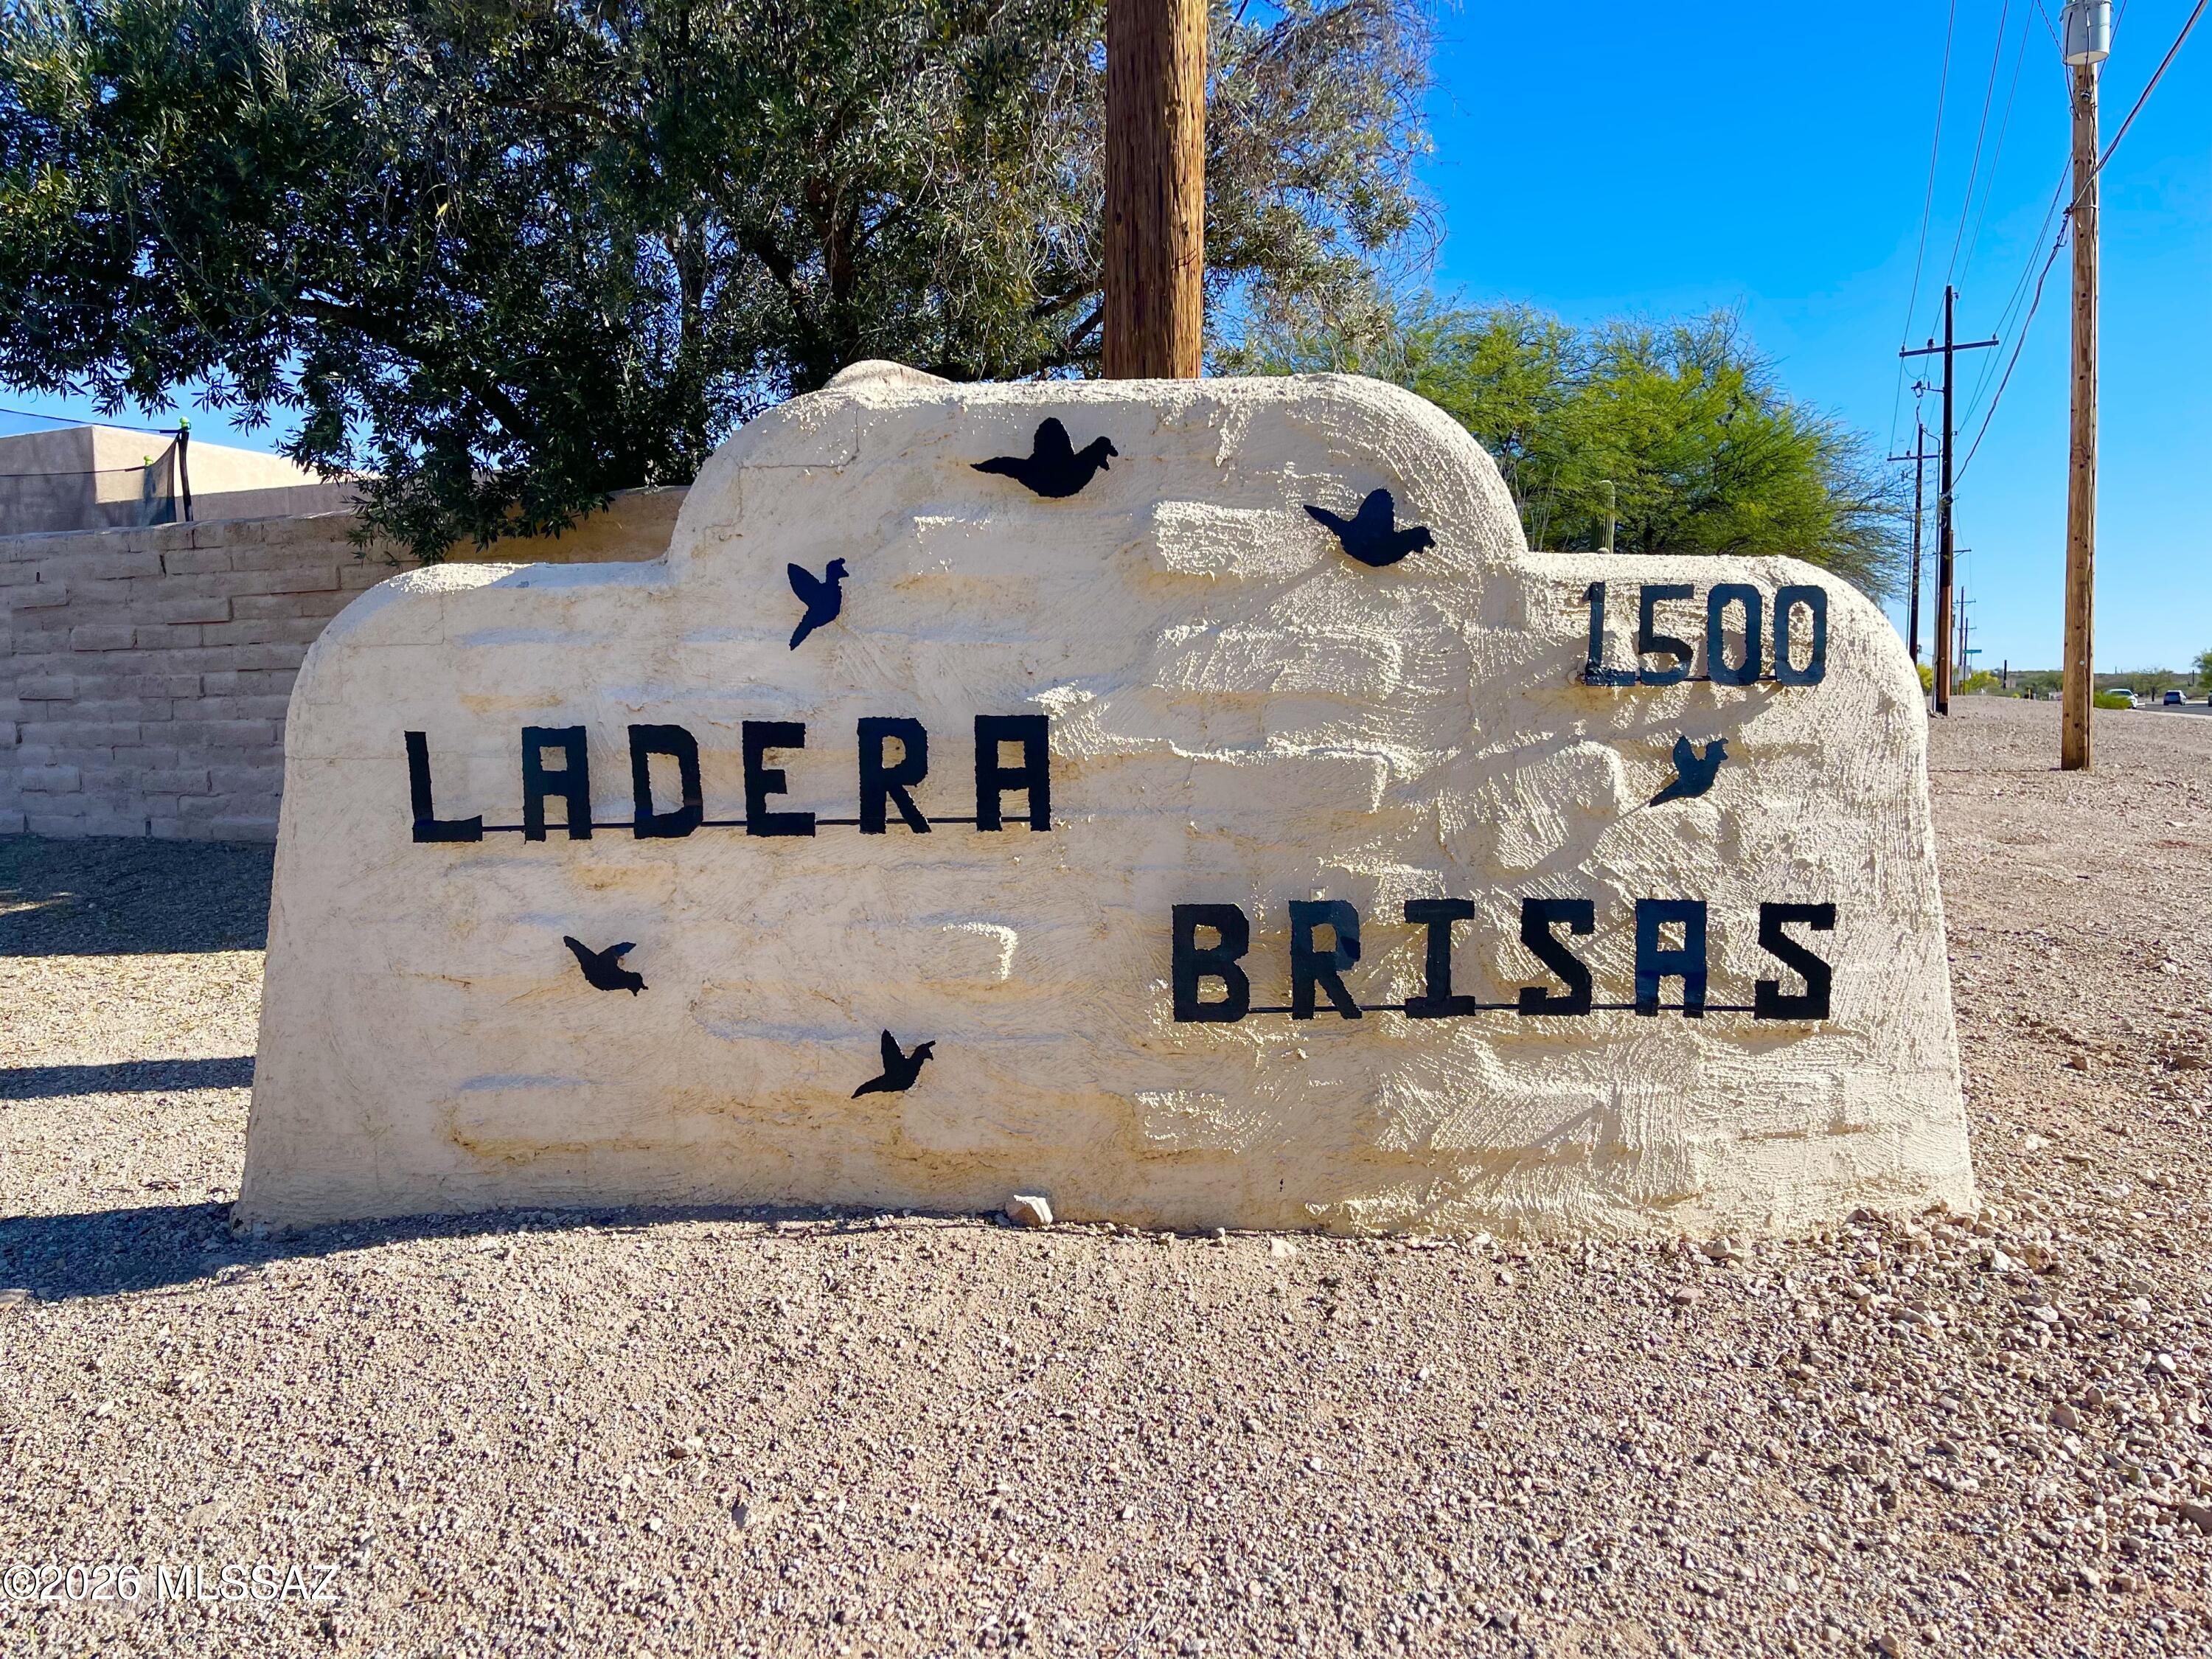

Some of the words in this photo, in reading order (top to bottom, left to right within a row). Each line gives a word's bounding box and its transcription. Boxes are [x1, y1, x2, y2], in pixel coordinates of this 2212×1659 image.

[1585, 582, 1827, 686] 1500
[405, 714, 1051, 844] LADERA
[1172, 897, 1836, 1023] BRISAS
